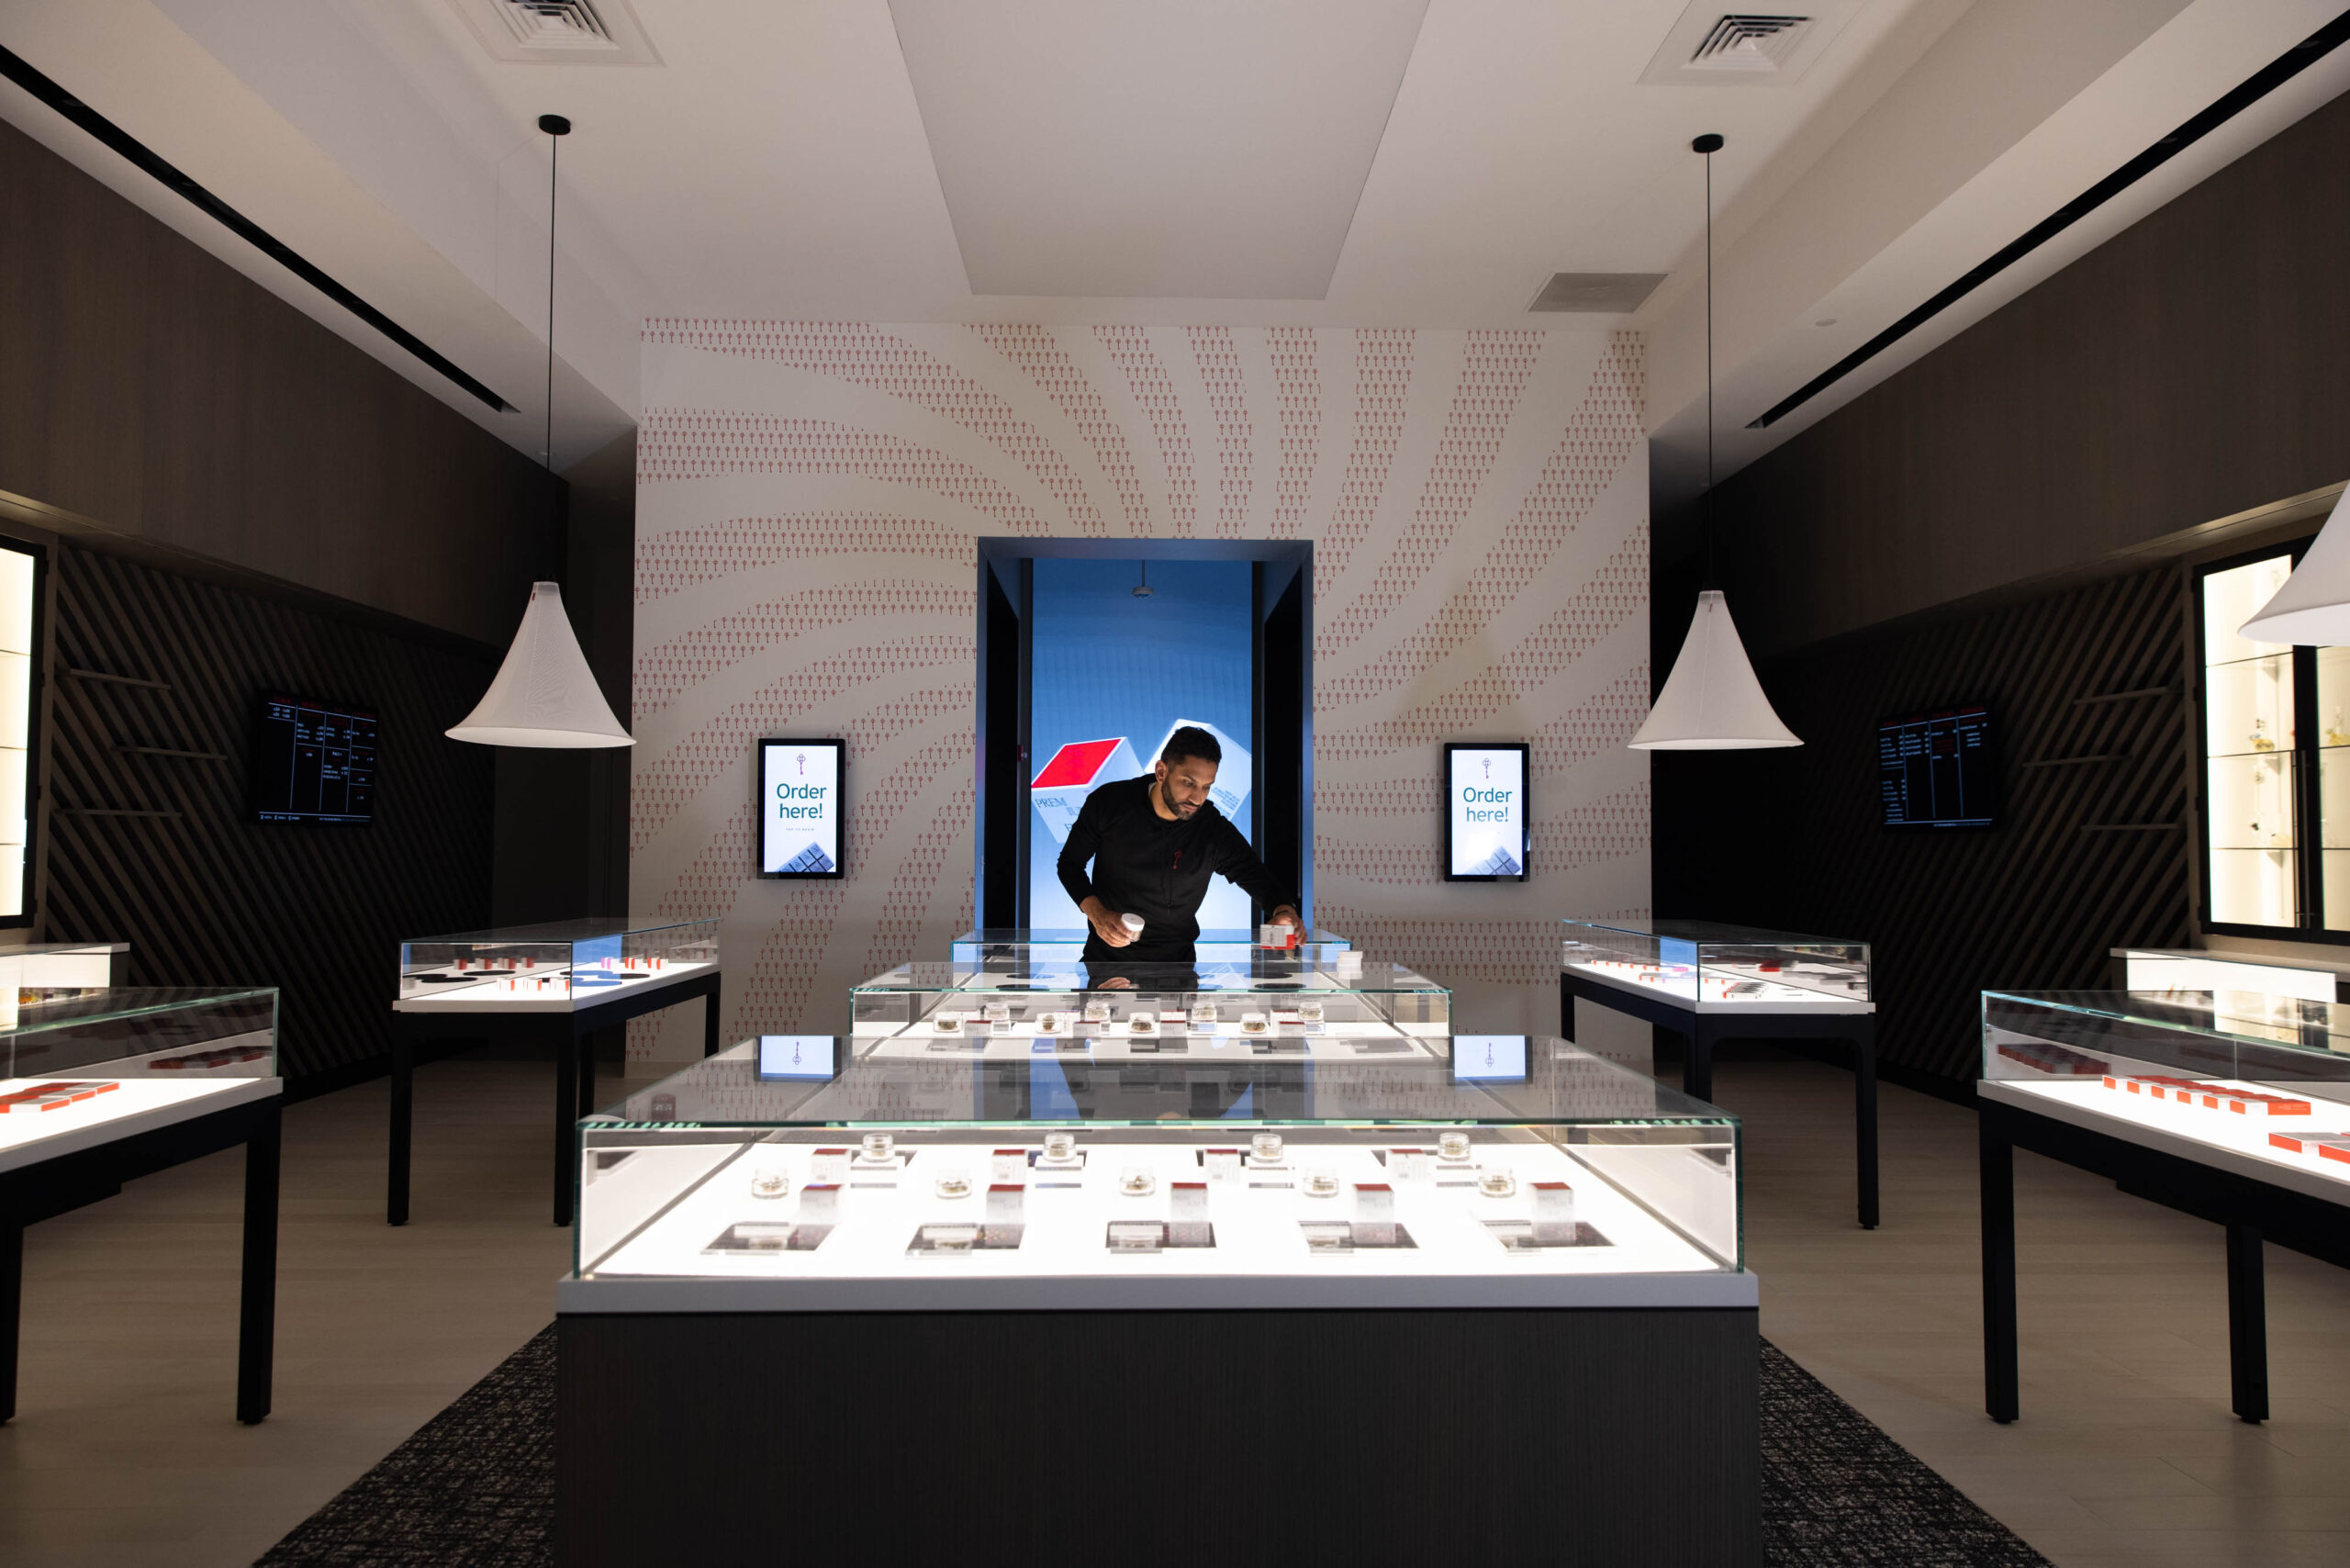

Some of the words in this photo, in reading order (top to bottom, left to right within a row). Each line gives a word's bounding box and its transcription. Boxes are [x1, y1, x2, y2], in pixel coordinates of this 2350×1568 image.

[777, 783, 827, 800] Order
[1463, 788, 1512, 802] Order
[779, 803, 822, 819] here!
[1466, 807, 1508, 823] here!
